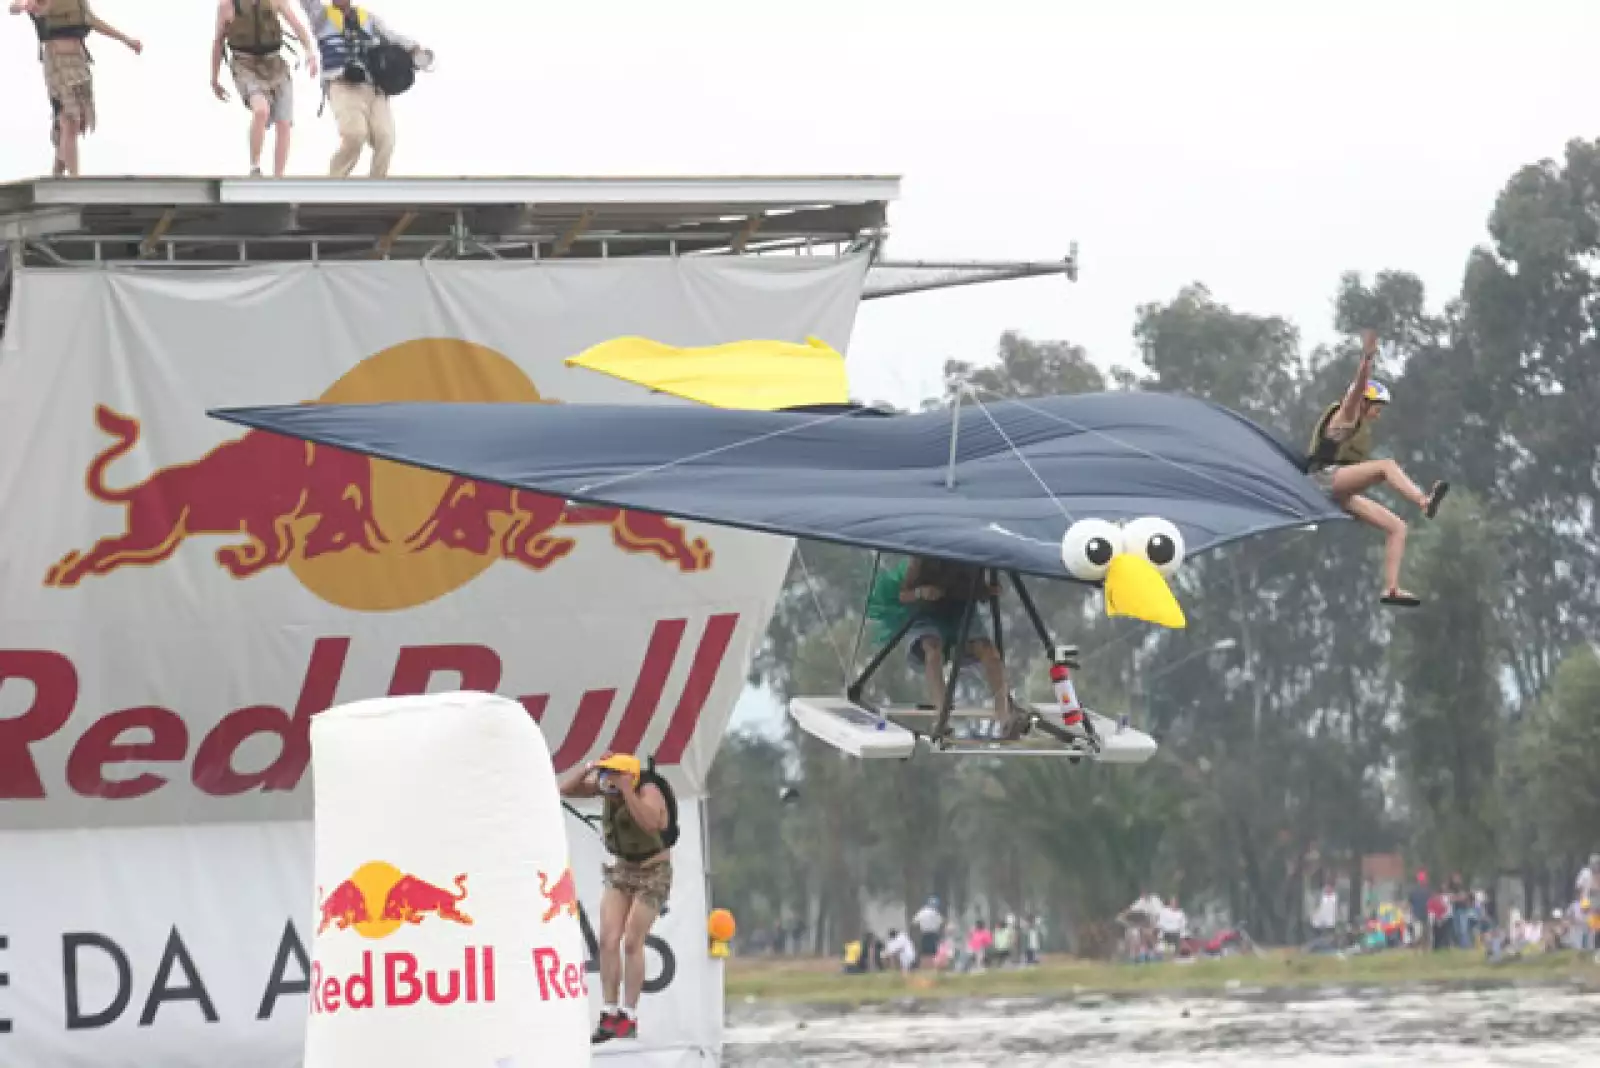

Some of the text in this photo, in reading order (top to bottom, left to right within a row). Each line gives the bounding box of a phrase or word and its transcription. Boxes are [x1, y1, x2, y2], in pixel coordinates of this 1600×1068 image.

[0, 637, 351, 799] Red
[62, 922, 220, 1030] DA
[309, 950, 374, 1014] Red
[384, 945, 496, 1006] Bull
